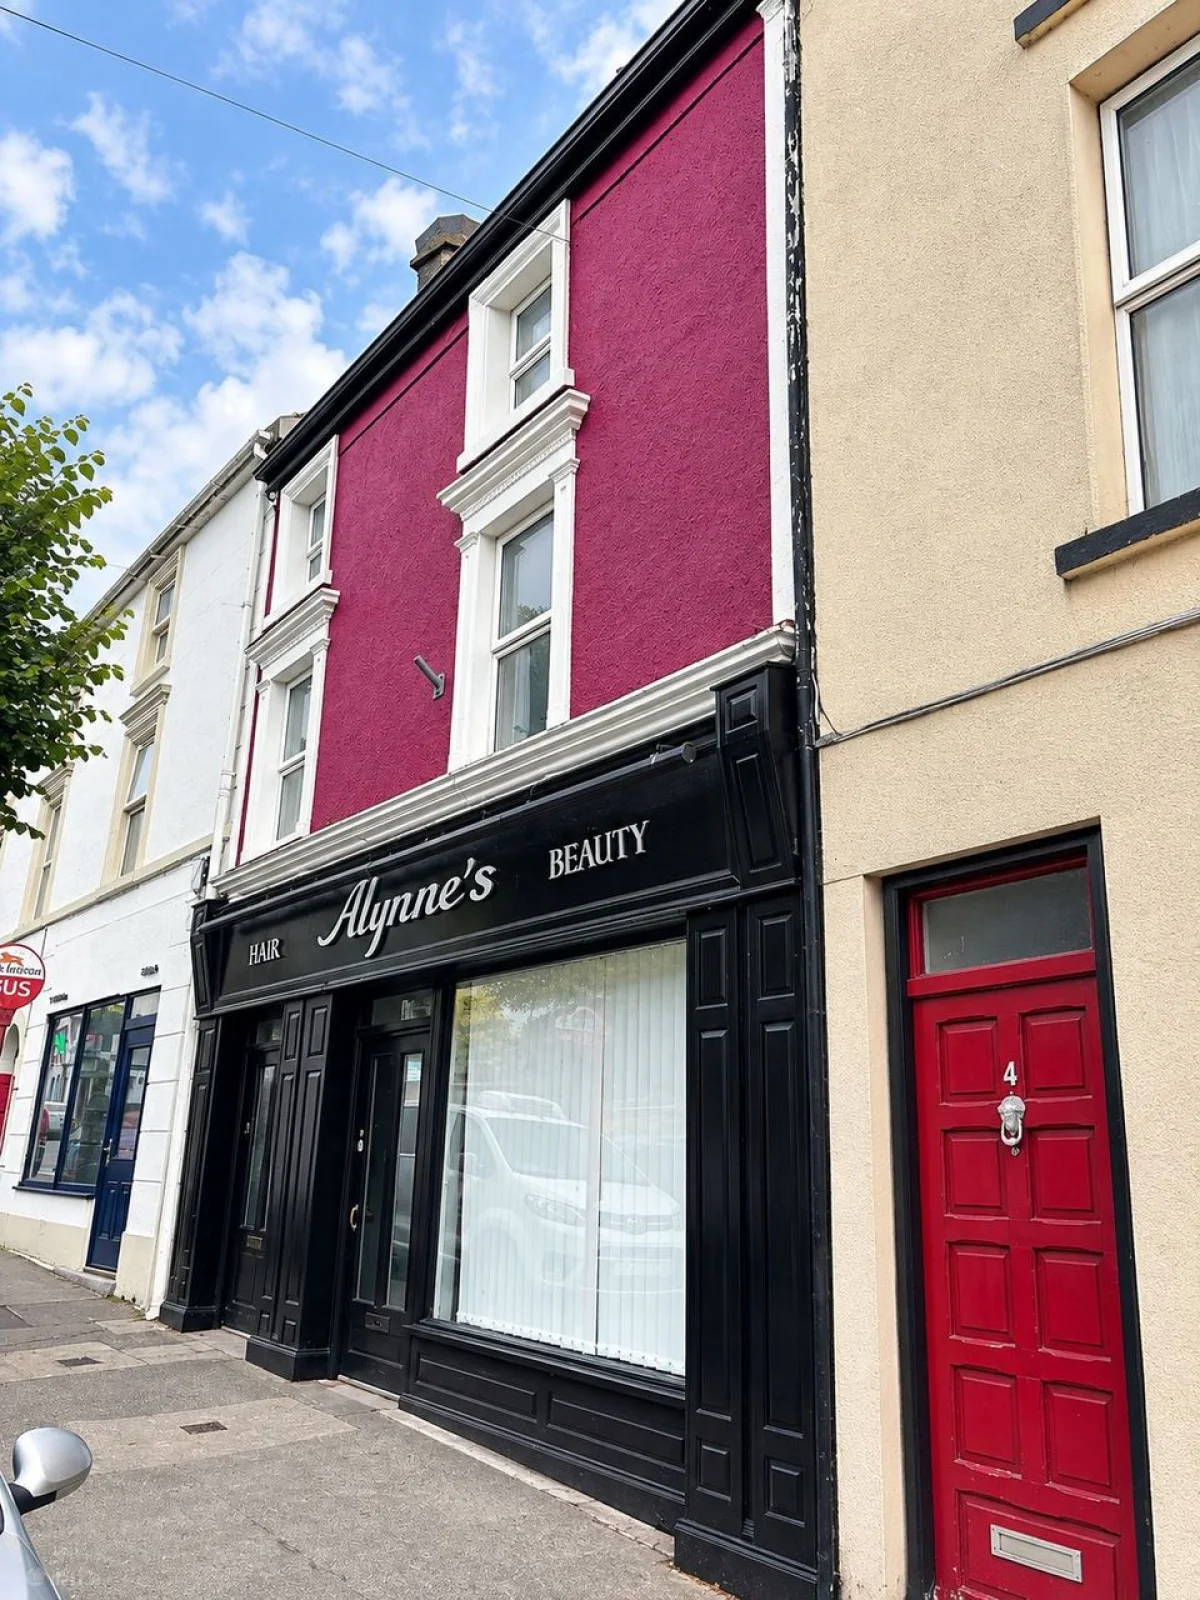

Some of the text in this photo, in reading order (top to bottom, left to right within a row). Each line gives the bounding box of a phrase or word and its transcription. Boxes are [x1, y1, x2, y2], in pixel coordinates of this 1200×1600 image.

[249, 819, 650, 966] HAIR Alynne's BEAUTY
[1003, 1060, 1018, 1086] 4
